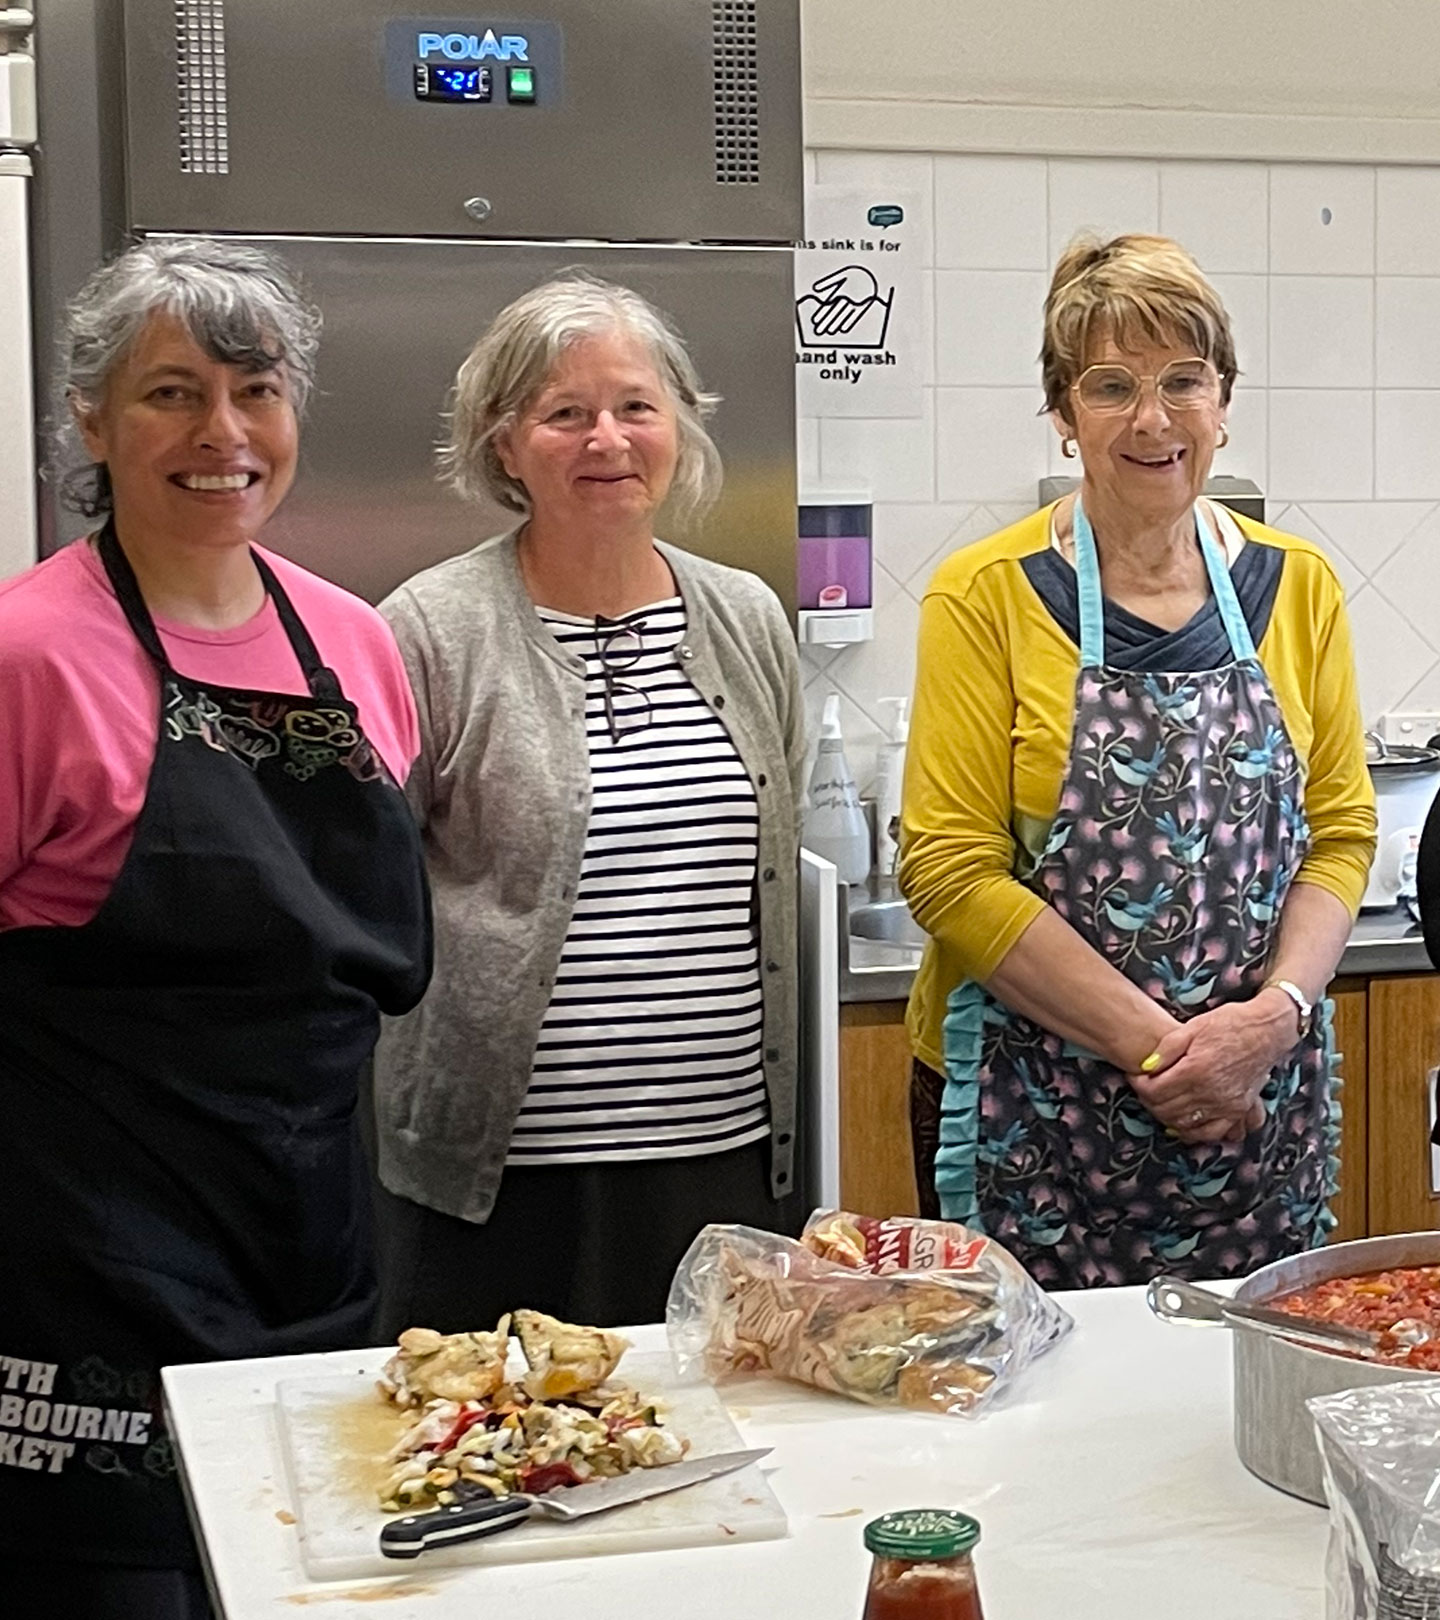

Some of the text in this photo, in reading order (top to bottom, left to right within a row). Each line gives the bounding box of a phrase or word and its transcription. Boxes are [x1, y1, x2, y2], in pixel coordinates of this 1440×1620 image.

[821, 239, 855, 250] sink
[860, 239, 874, 250] is
[879, 239, 901, 251] for
[844, 350, 896, 365] wash
[820, 366, 862, 384] only
